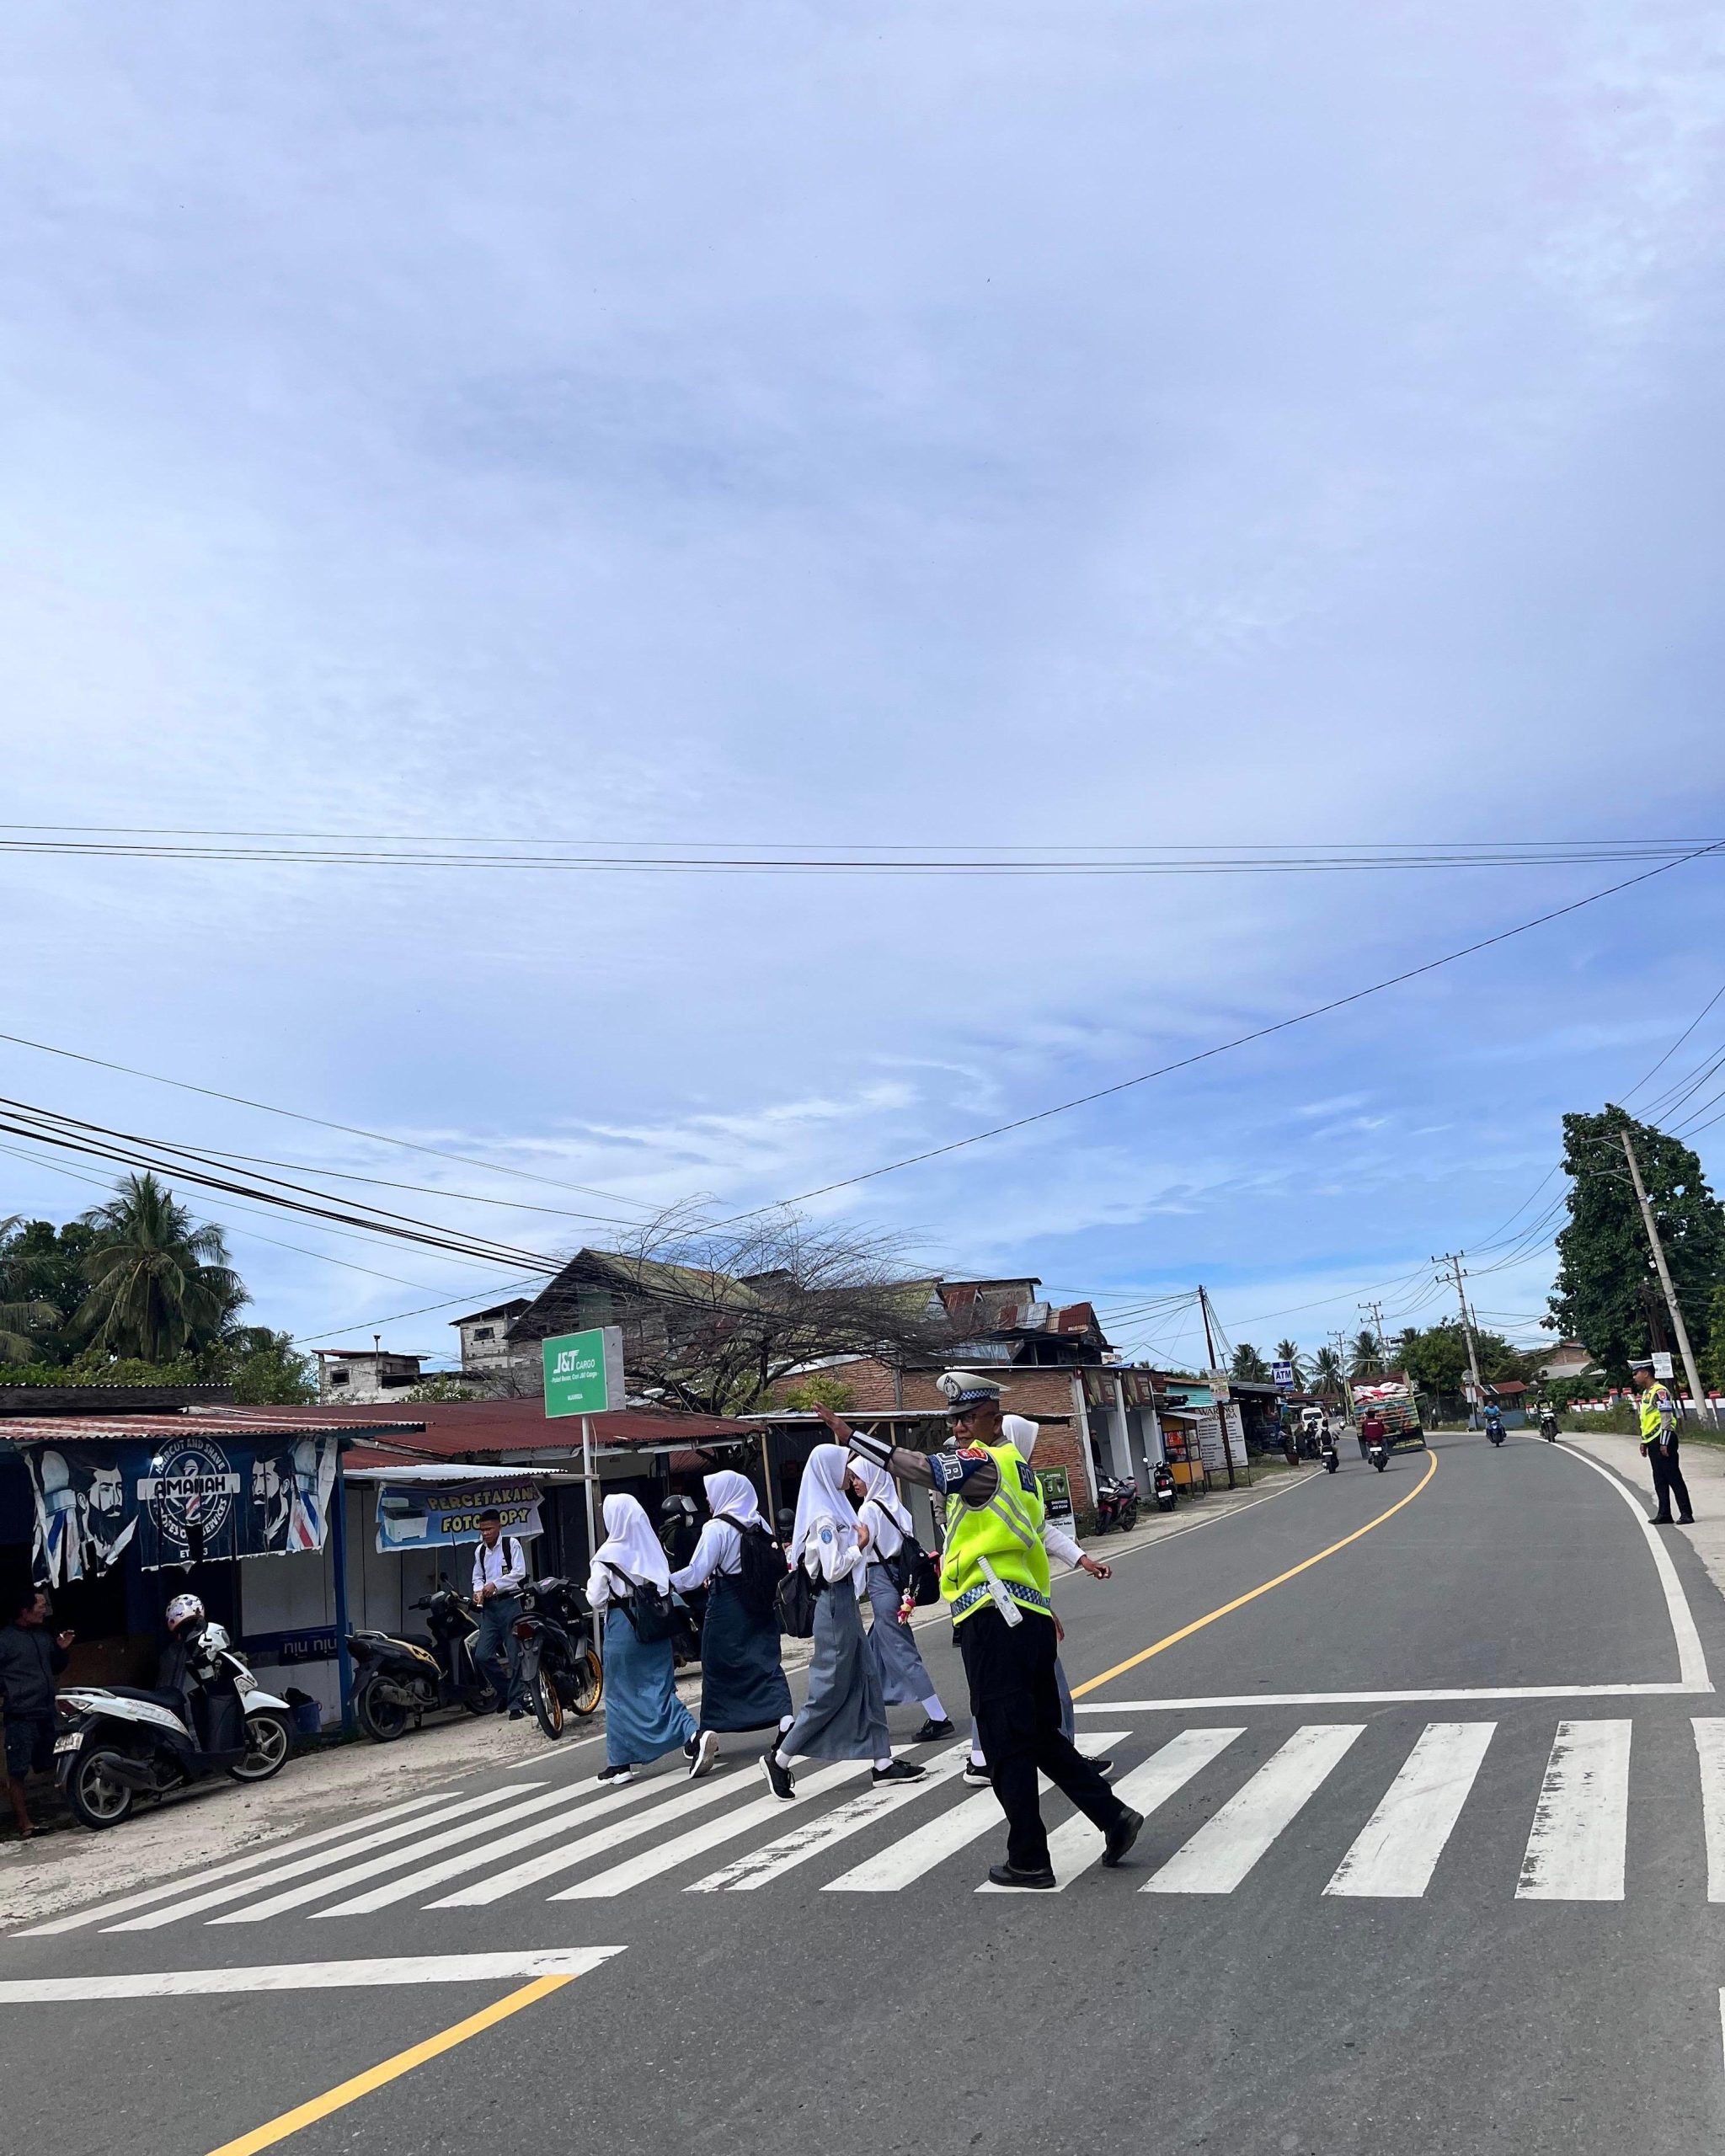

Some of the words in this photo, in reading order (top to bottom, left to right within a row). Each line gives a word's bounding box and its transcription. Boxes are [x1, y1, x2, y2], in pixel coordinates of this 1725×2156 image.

[553, 1349, 579, 1374] J&T
[575, 1358, 595, 1370] CARGO
[1276, 1369, 1291, 1380] ATM
[1199, 1406, 1235, 1416] WARNG
[186, 1438, 204, 1449] AND
[205, 1444, 226, 1470] SHAVE
[154, 1476, 226, 1497] AMANAH
[441, 1508, 531, 1534] FOTOOPY
